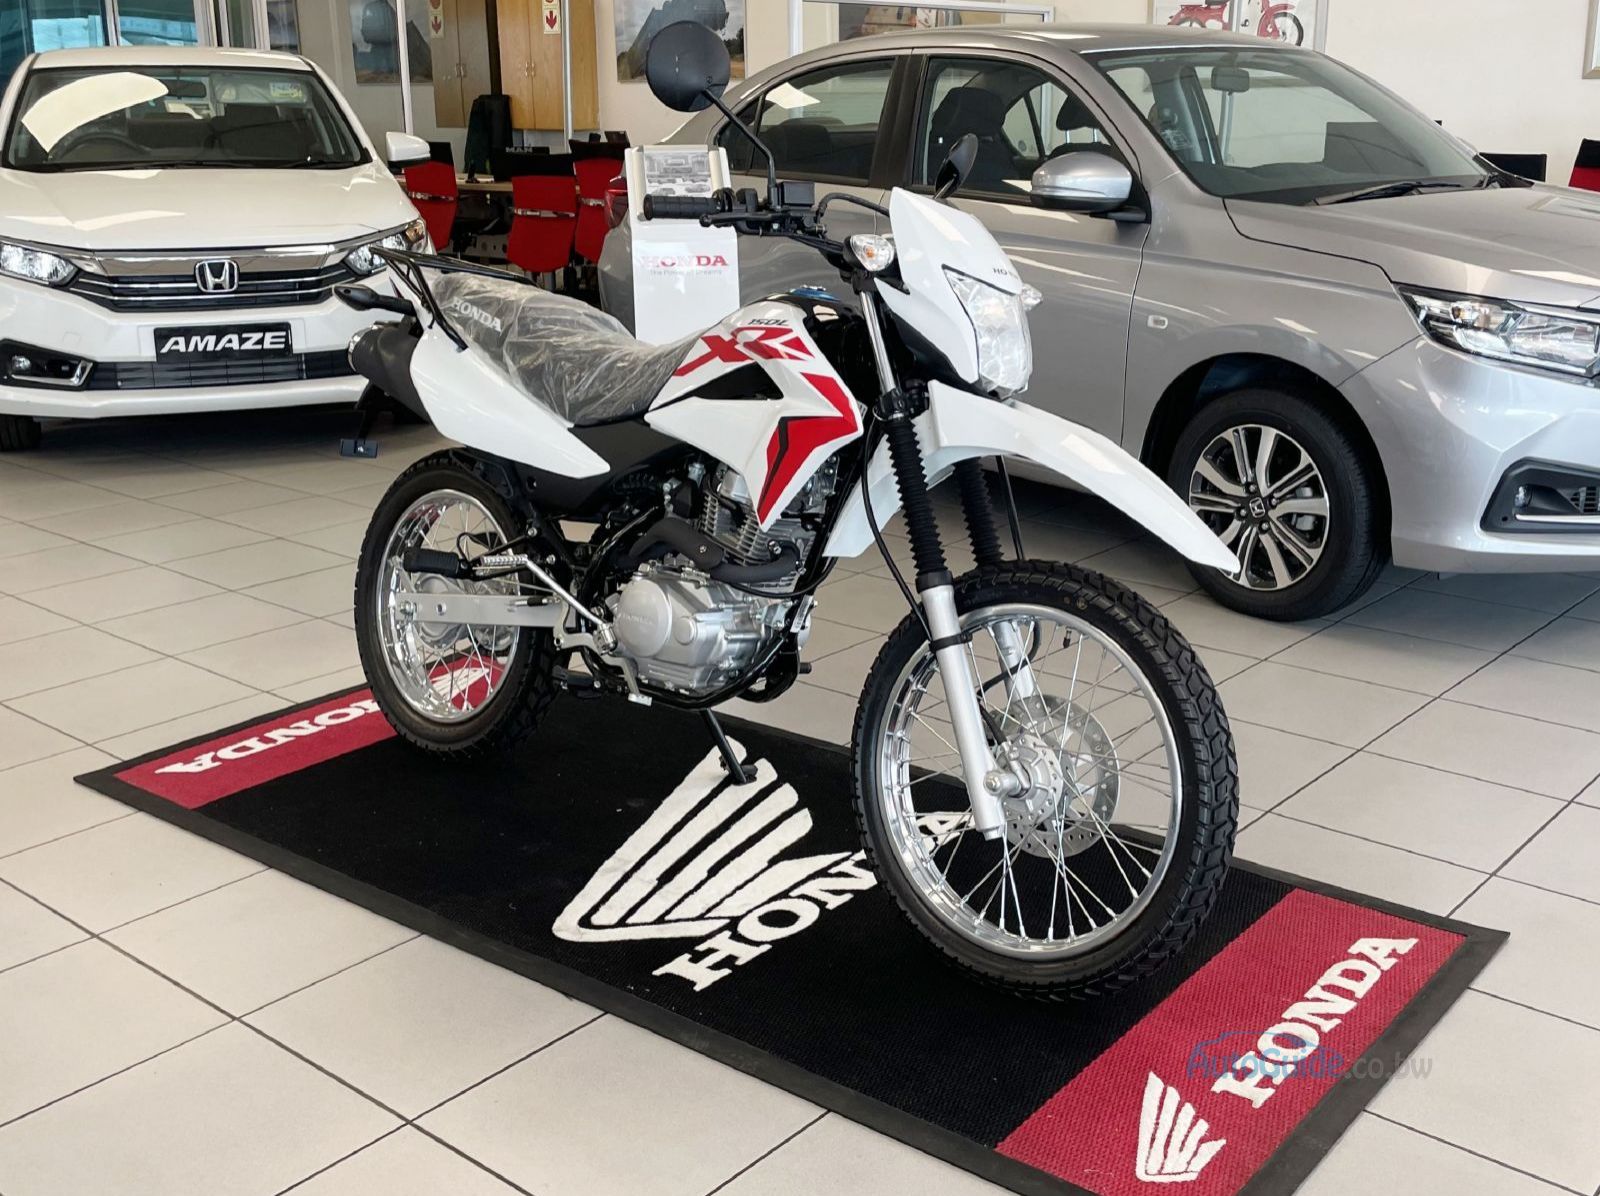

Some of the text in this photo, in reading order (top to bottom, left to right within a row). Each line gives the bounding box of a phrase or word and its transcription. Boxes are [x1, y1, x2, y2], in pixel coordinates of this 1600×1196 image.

[160, 331, 287, 353] AMAZE
[451, 296, 502, 332] HONDA
[651, 811, 976, 992] HONA
[1211, 938, 1419, 1109] HONDA
